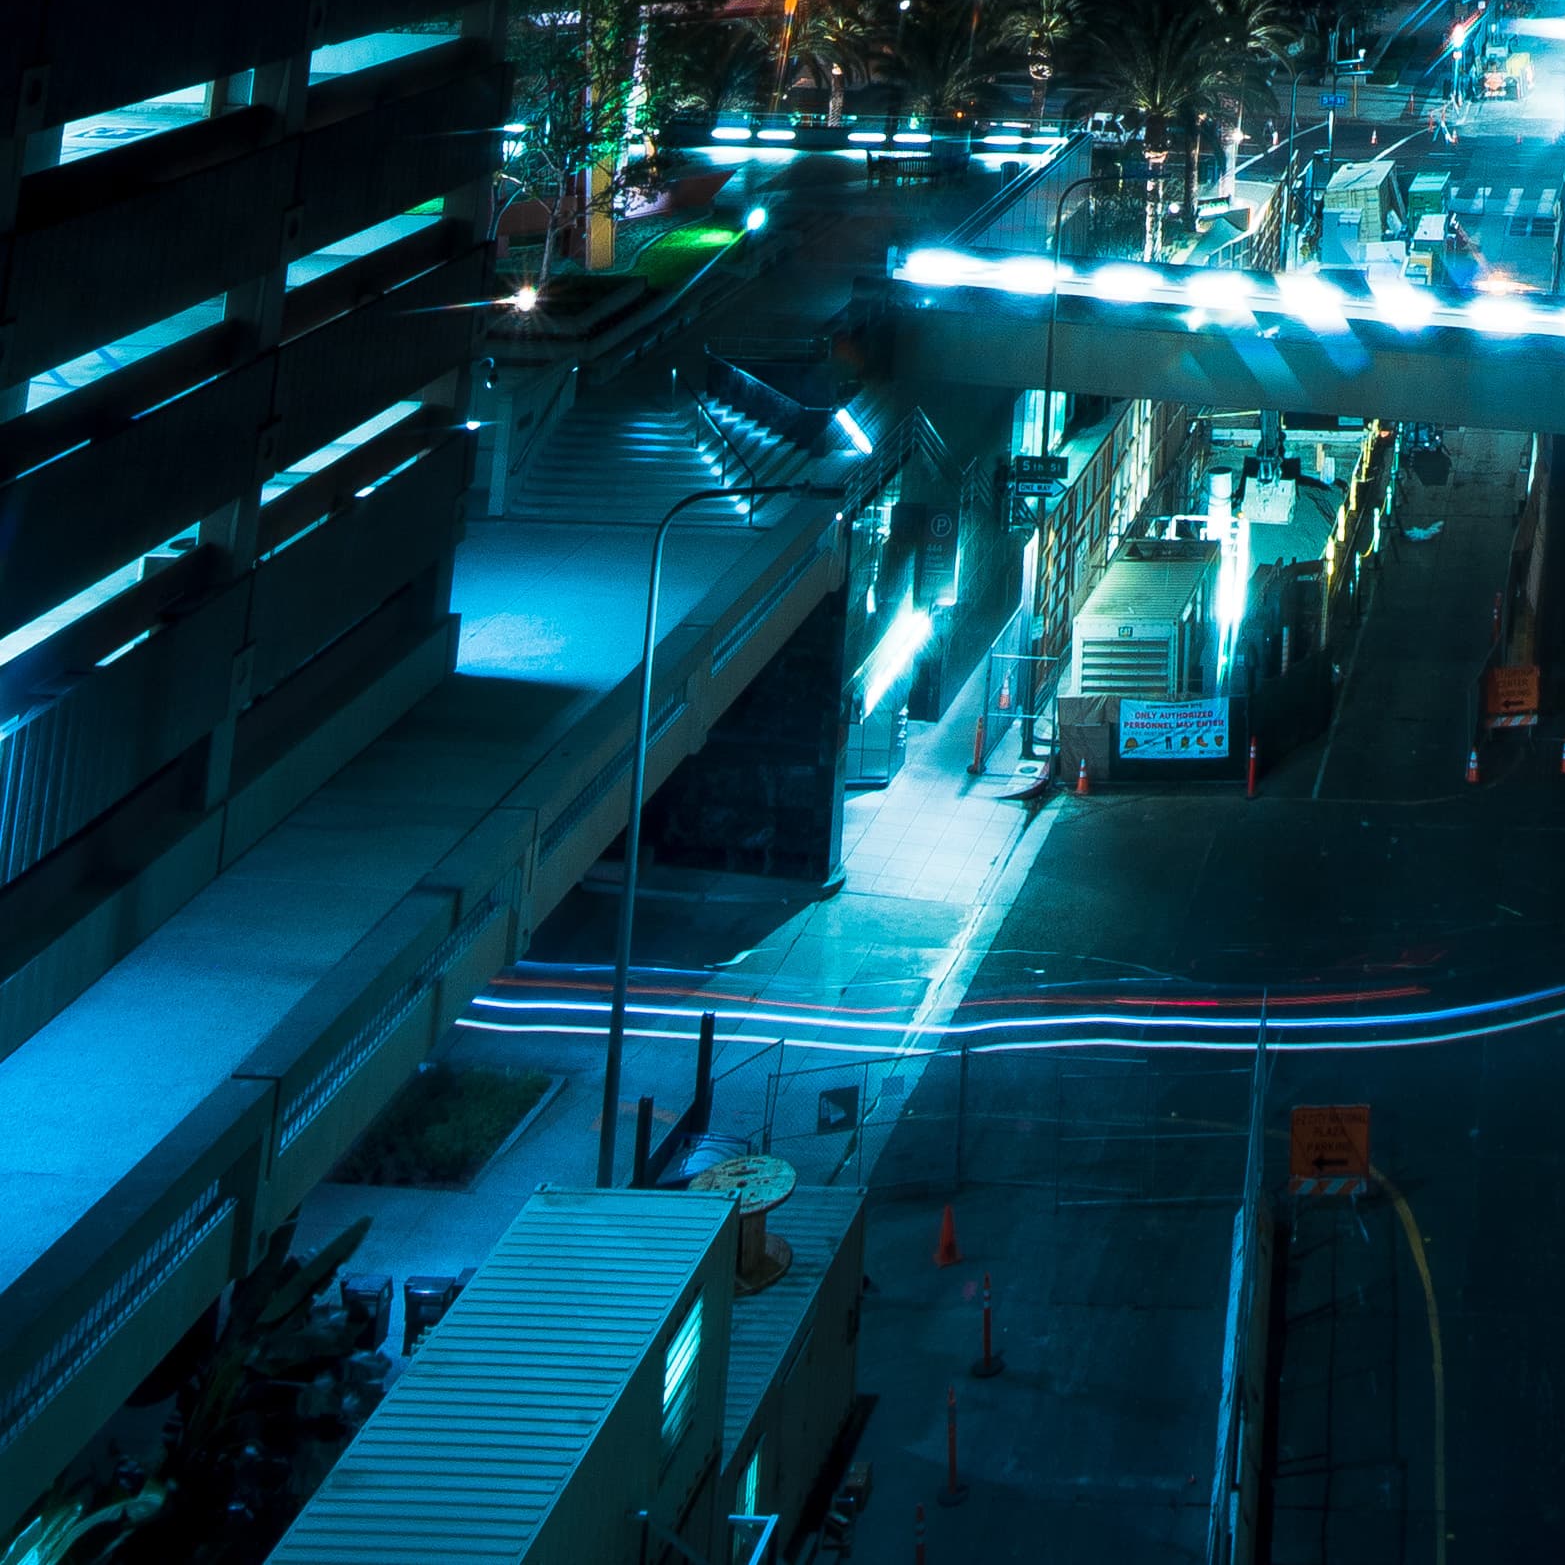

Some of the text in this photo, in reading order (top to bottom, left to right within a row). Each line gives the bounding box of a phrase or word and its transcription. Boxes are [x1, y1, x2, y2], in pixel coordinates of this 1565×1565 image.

[1134, 710, 1214, 719] ONLY AUTHORIZED
[1123, 719, 1224, 729] PERSONNEL MAY ENTER
